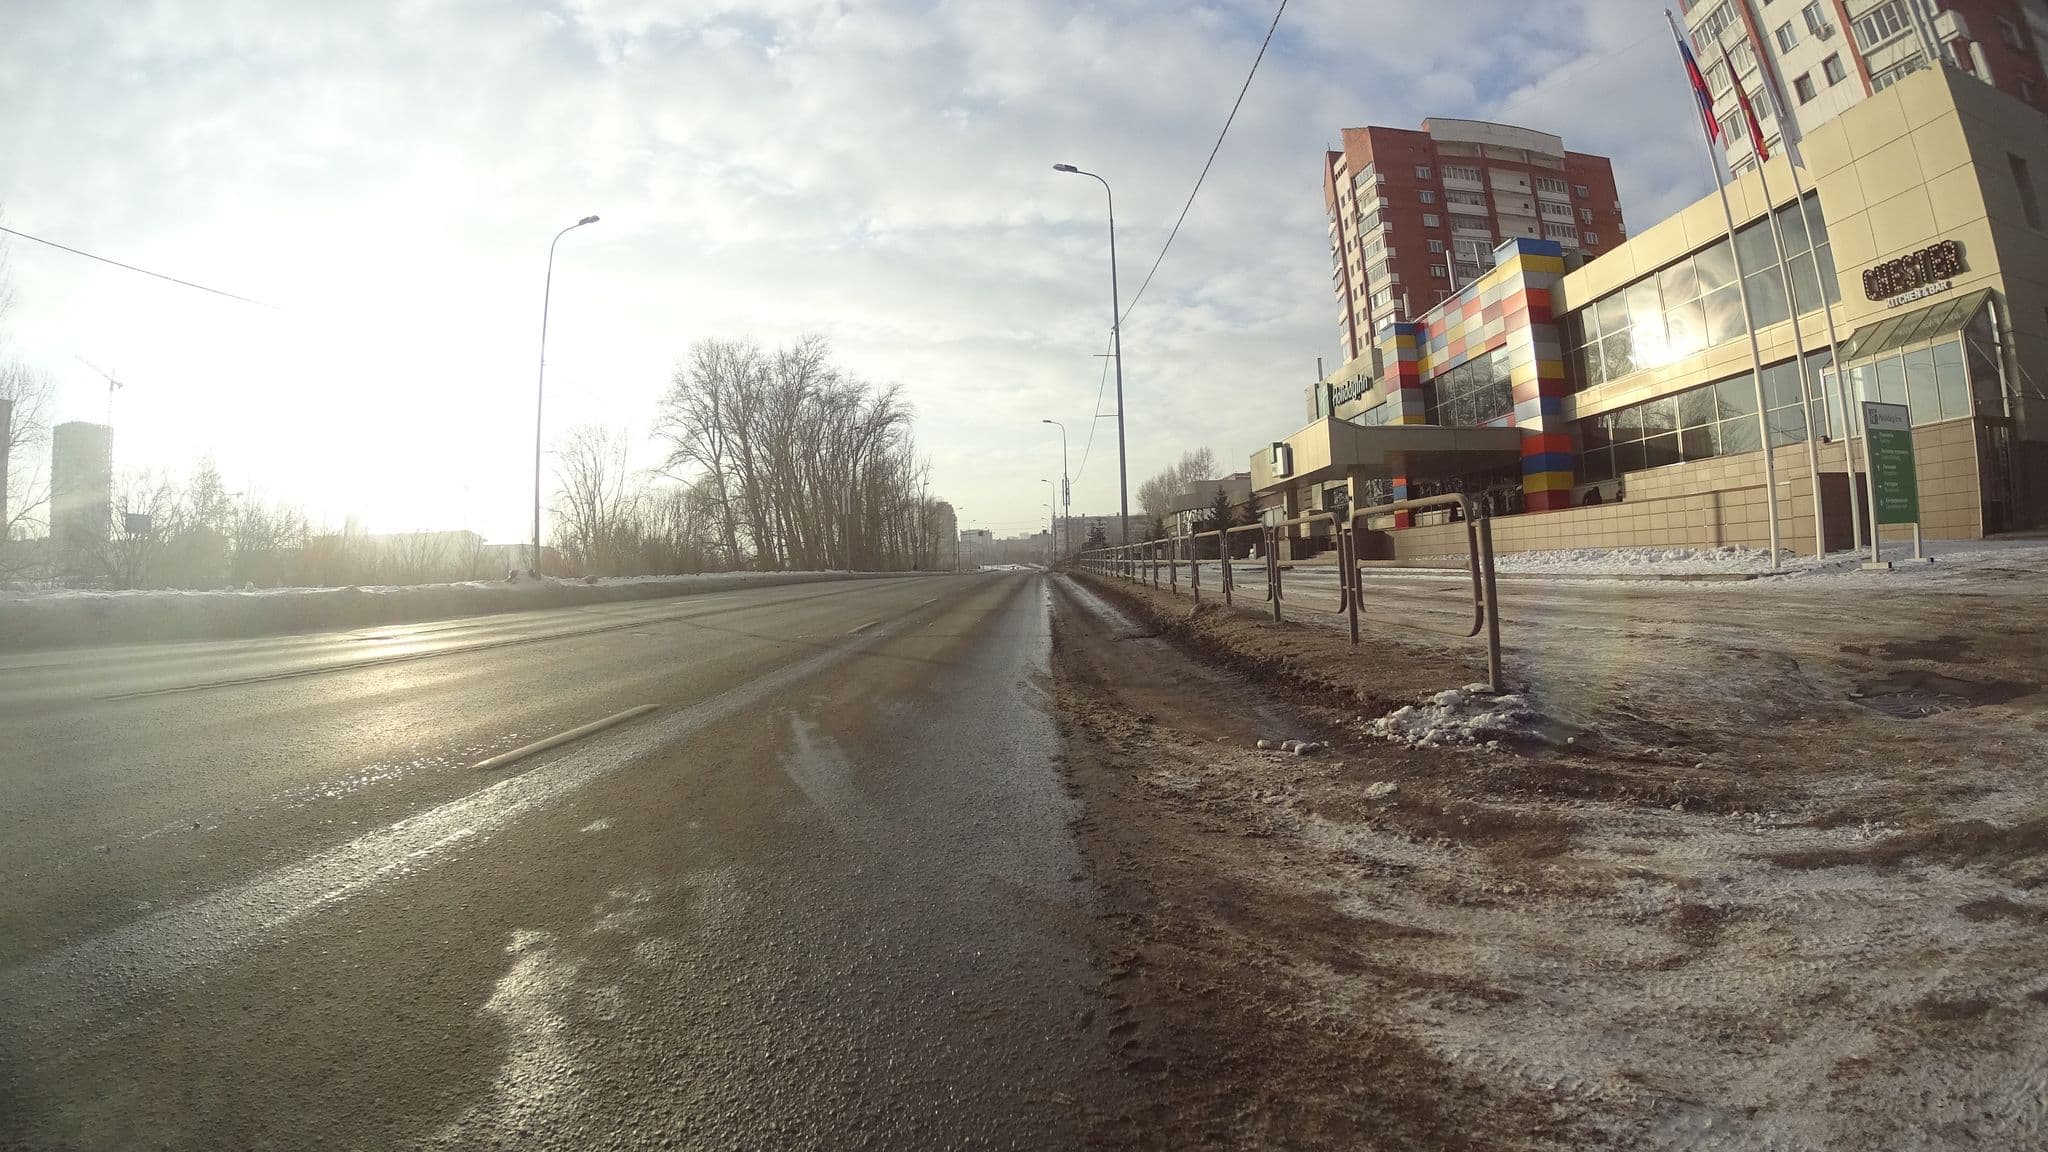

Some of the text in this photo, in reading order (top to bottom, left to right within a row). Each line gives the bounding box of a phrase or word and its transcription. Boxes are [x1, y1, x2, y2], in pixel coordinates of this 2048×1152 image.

[1863, 240, 1961, 301] CHESTER
[1887, 286, 1921, 309] KITCHEN
[1928, 280, 1949, 294] BAR
